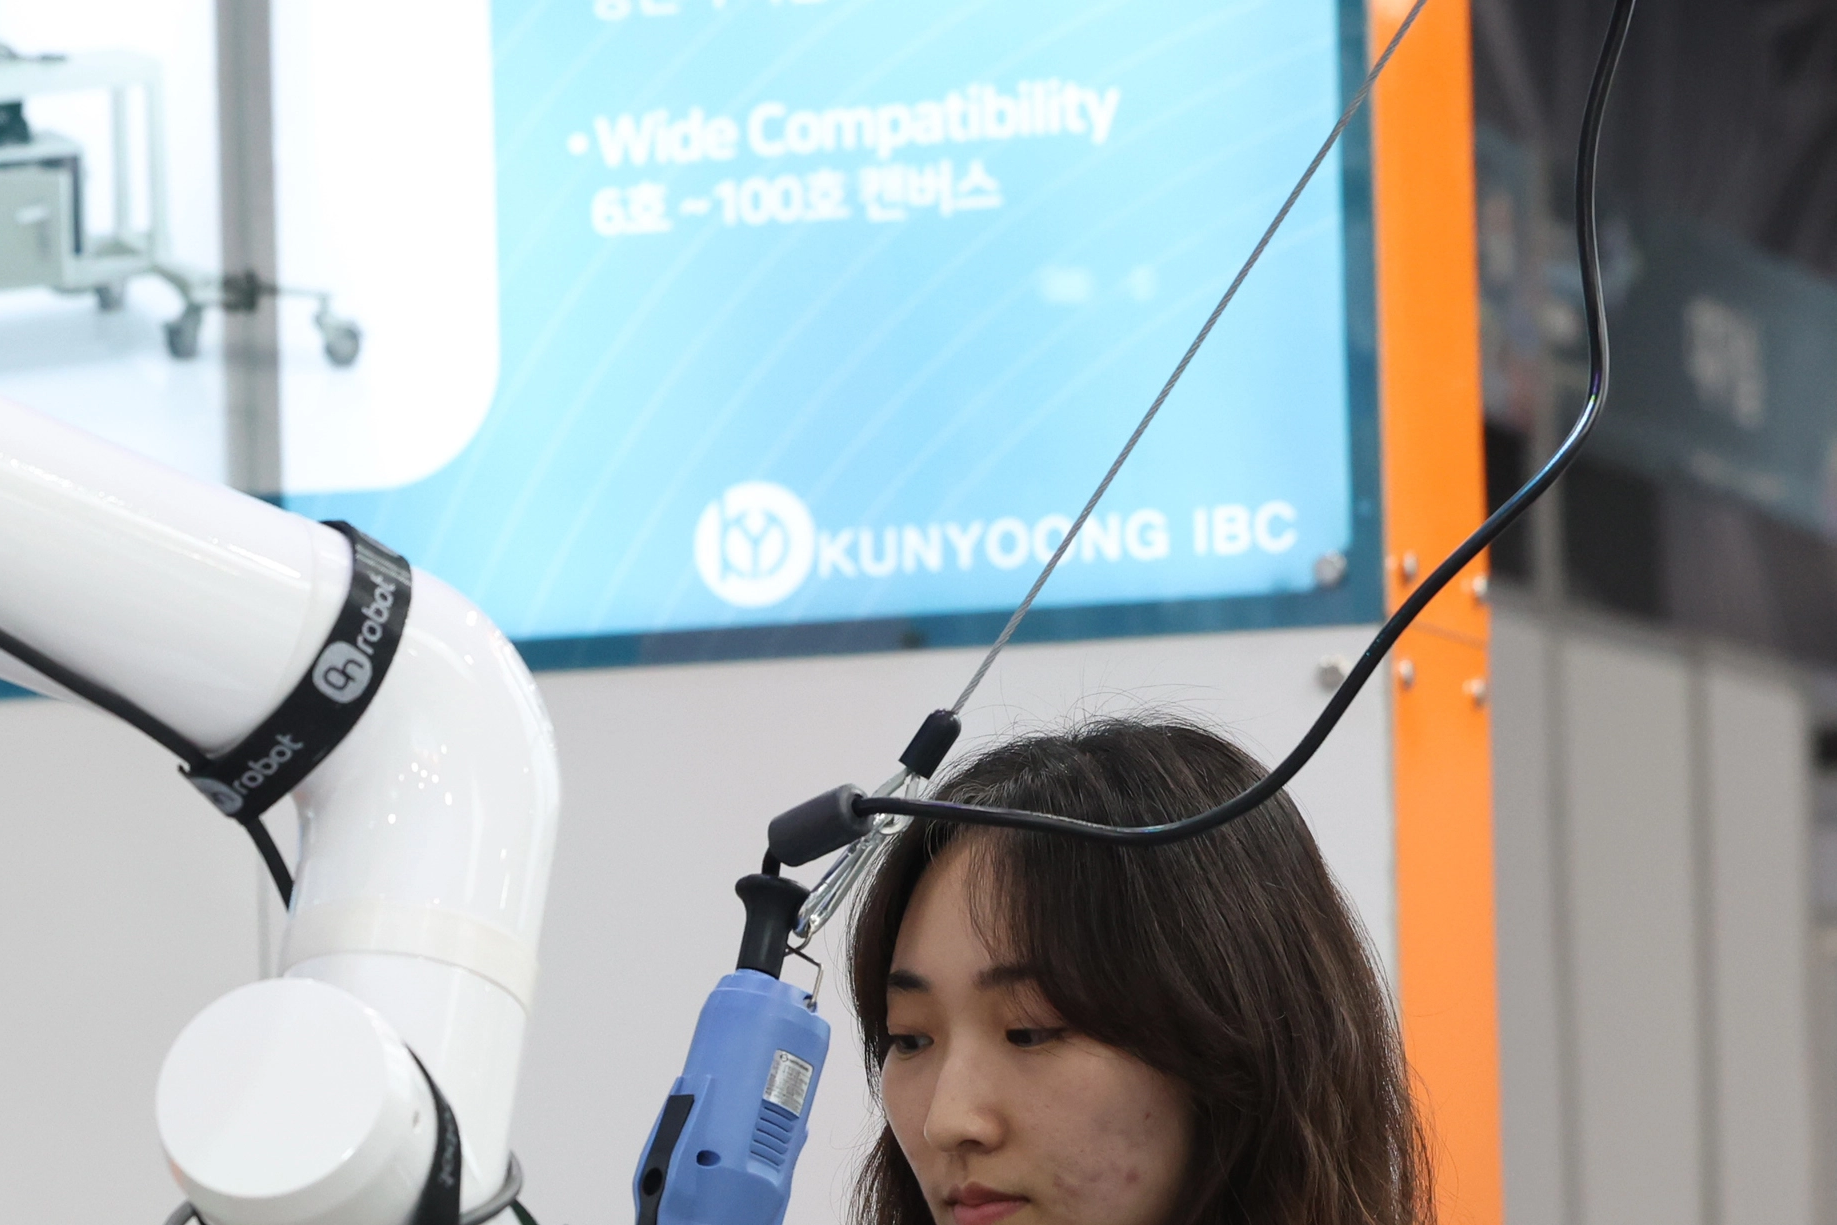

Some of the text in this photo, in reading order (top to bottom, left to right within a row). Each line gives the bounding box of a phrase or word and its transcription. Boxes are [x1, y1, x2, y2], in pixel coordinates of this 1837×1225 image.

[593, 76, 1121, 168] Wide Compatibility
[818, 499, 1299, 579] KUNYOONG IBC
